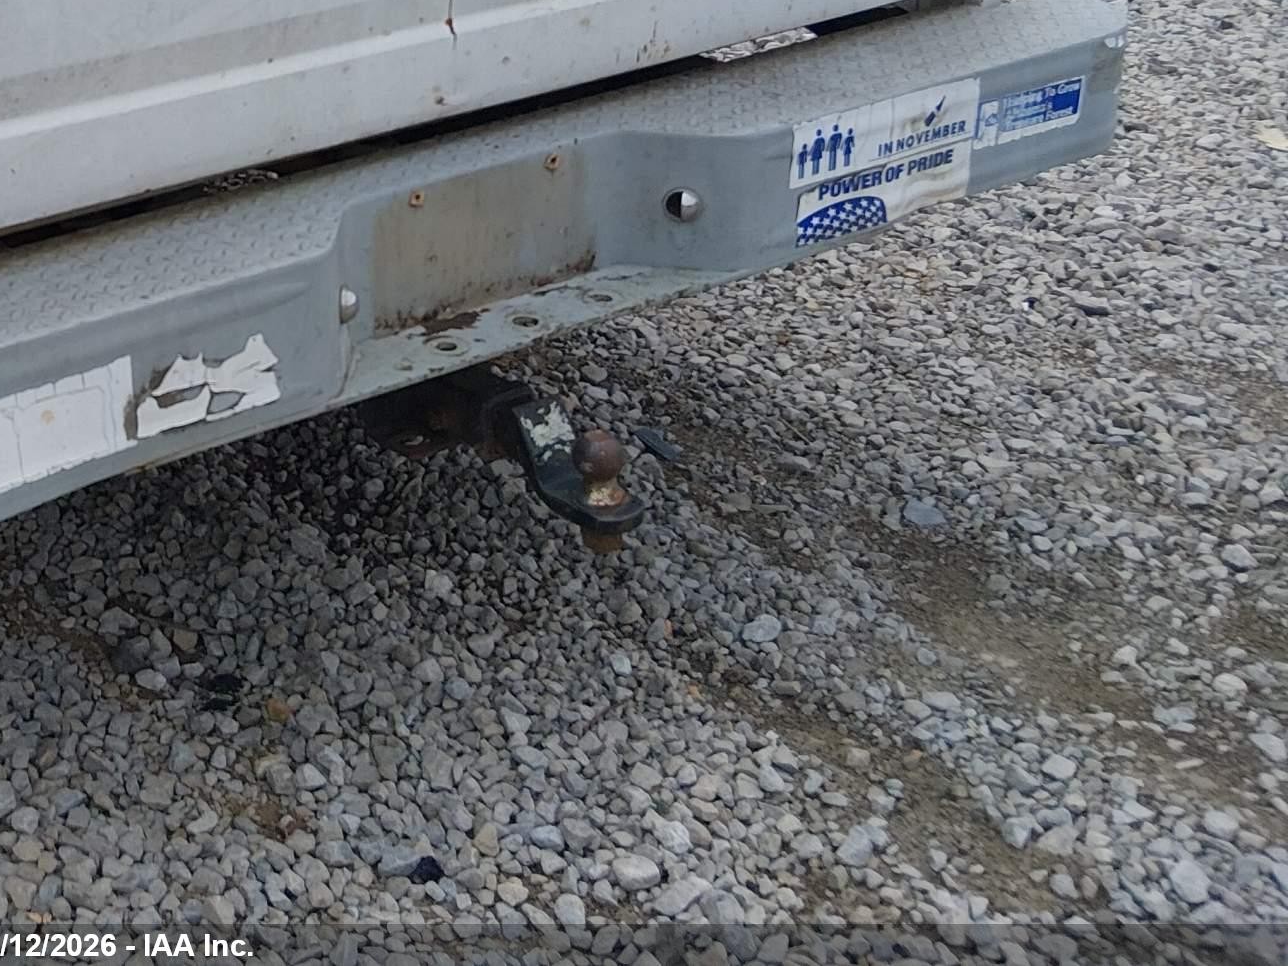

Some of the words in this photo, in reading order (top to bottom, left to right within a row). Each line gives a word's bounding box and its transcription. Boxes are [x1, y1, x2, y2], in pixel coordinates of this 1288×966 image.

[877, 140, 893, 156] IN
[896, 120, 967, 150] NOVEMBER
[818, 170, 882, 201] POWER
[885, 163, 904, 181] OF
[907, 149, 954, 176] PRIDE
